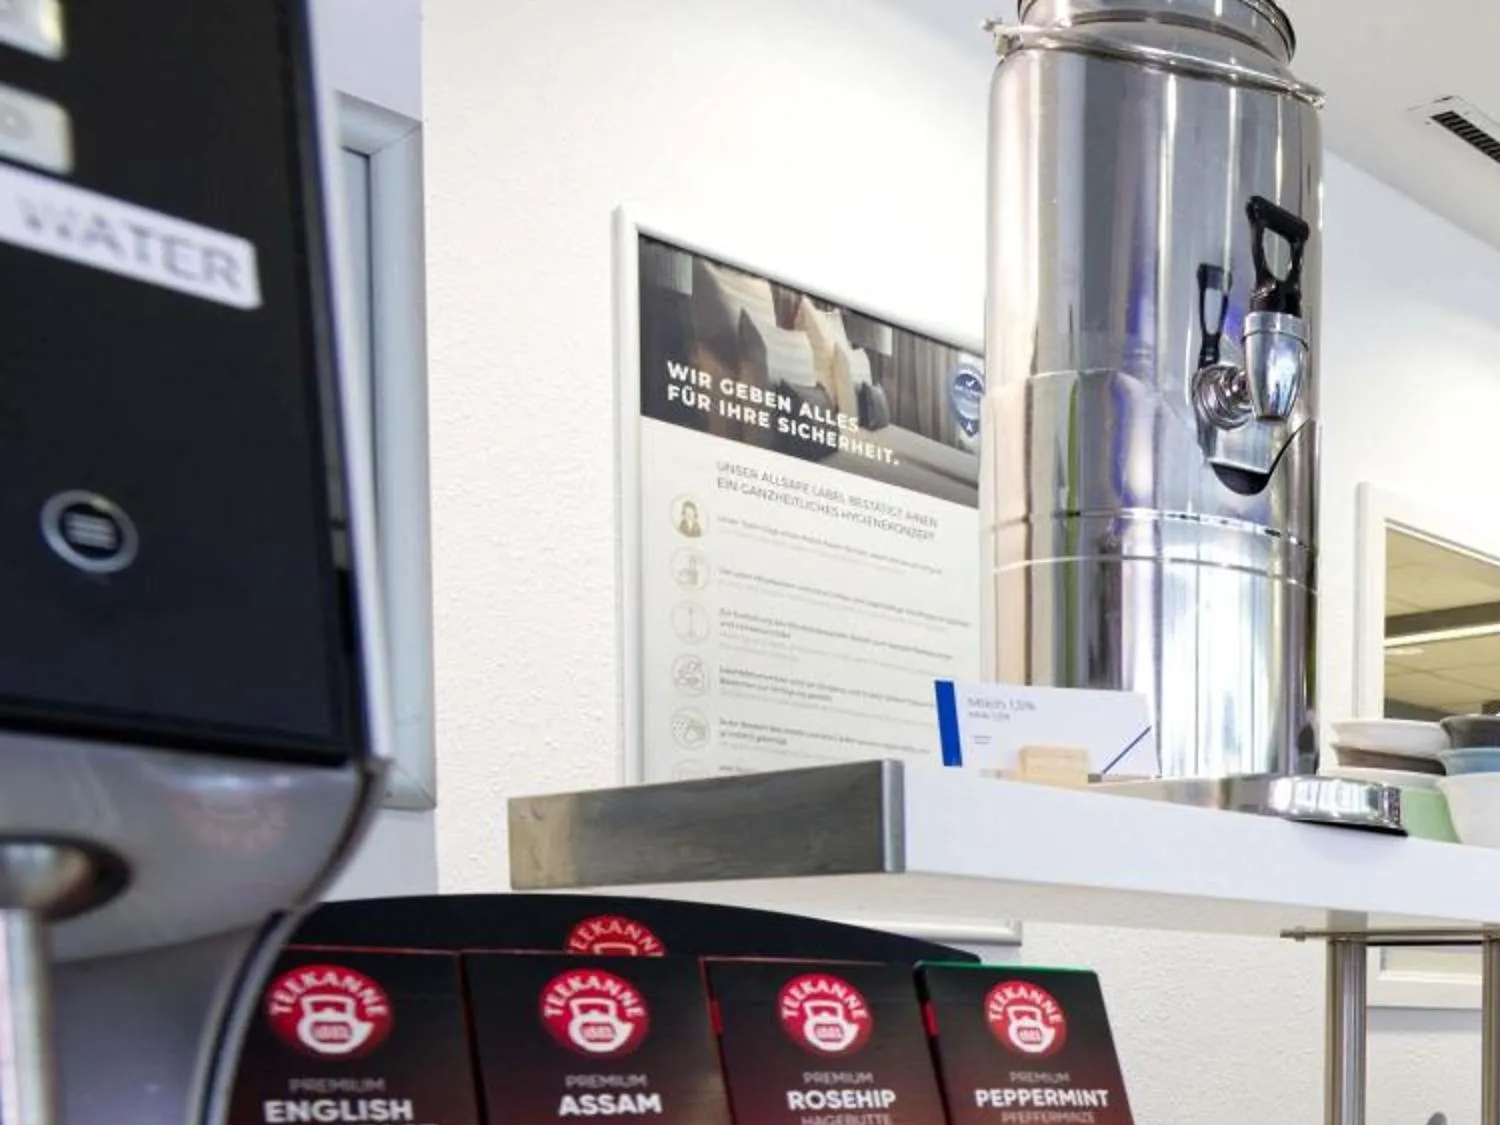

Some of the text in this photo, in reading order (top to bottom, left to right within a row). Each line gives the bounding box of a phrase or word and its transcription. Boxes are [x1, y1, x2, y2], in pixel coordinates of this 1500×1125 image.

[15, 196, 243, 293] WATER
[667, 361, 859, 433] WIR GEBEN ALLES
[667, 384, 899, 466] FÜR IHRE SICHERHEIT.
[717, 461, 757, 478] UNSER
[717, 476, 738, 489] EIN
[270, 970, 389, 1017] TEEKANNE
[543, 975, 648, 1019] TEEKANNE
[781, 979, 868, 1020] TEEKANNE
[988, 986, 1063, 1023] TEEKANNE
[289, 1077, 385, 1092] PREMIUM
[565, 1074, 648, 1088] PREMIUM
[802, 1071, 873, 1085] PREMIUM
[1009, 1071, 1070, 1084] PREMIUM
[559, 1093, 663, 1116] ASSAM
[786, 1088, 896, 1111] ROSEHIP
[974, 1088, 1109, 1108] PEPPERMINT
[264, 1099, 414, 1124] ENGLISH
